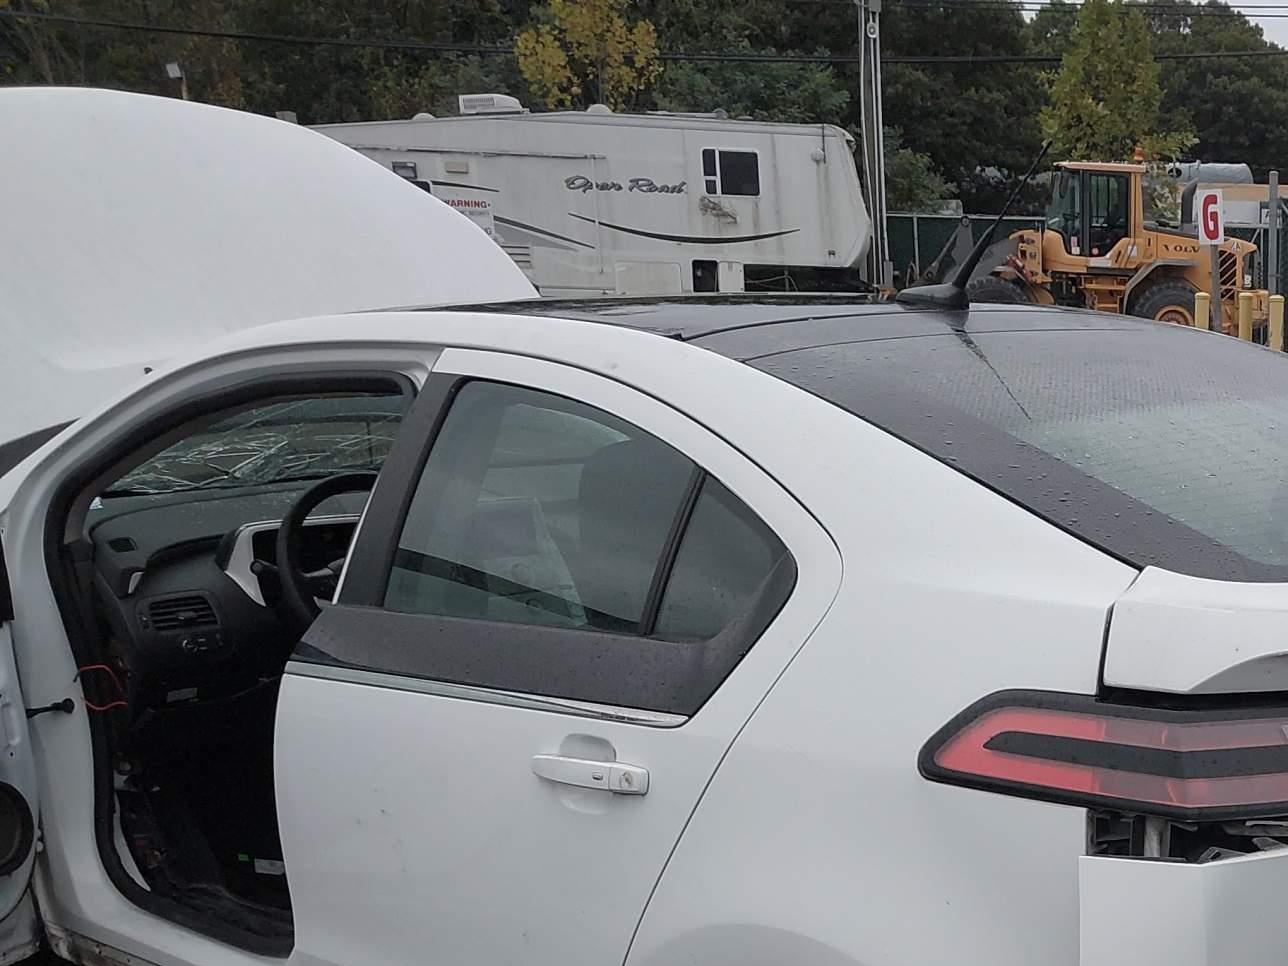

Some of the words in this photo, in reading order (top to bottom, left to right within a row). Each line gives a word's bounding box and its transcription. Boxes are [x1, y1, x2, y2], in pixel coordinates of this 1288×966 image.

[628, 177, 687, 194] Road
[1202, 193, 1220, 241] G
[1163, 244, 1200, 253] VOLV
